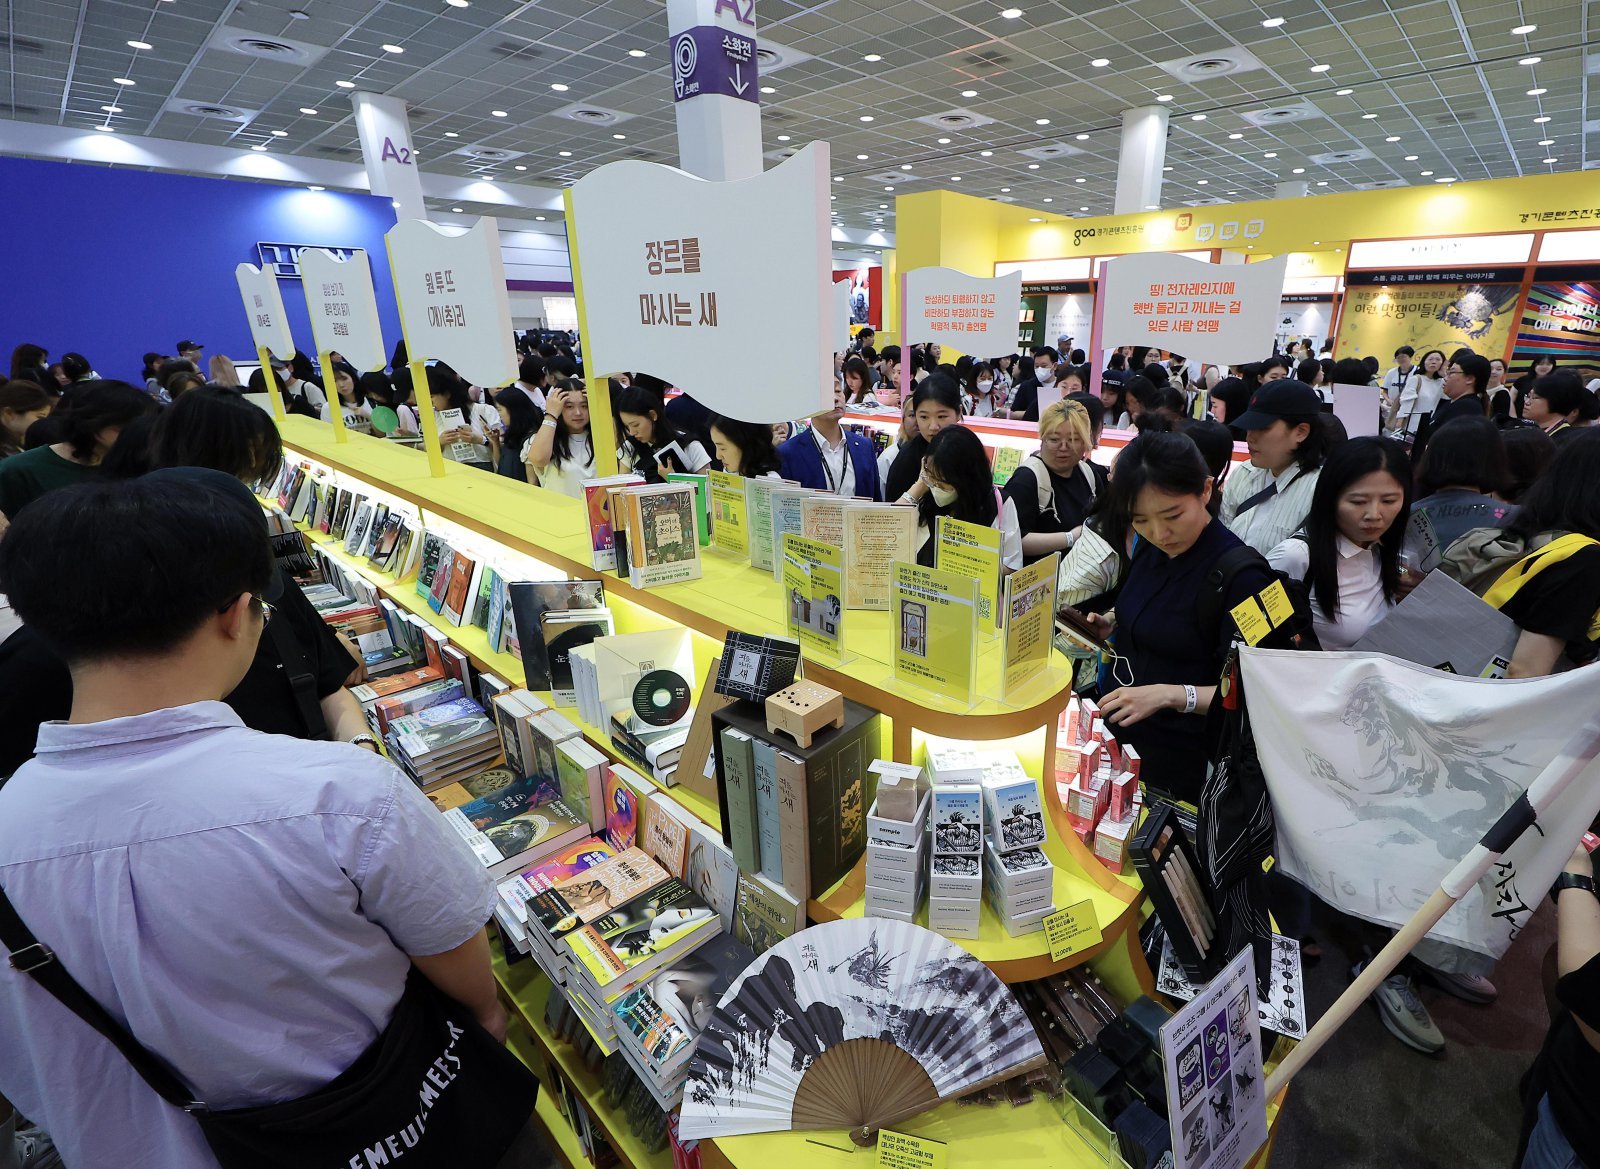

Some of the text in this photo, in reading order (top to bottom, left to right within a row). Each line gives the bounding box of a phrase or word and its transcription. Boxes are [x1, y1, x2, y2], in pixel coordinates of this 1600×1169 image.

[722, 35, 751, 57] 소화전
[685, 82, 699, 95] 소화전
[382, 136, 411, 164] A2
[1074, 228, 1095, 246] gca
[1096, 225, 1144, 236] 경기콘텐츠진흥원
[645, 237, 701, 275] 장르를
[1150, 281, 1235, 296] 띵! 전자레인지에
[981, 294, 995, 304] 않고
[640, 292, 717, 327] 마시는 새
[924, 308, 950, 318] 비판하되
[981, 308, 995, 318] 않는
[1133, 300, 1241, 314] 햇반 돌리고 꺼내는 걸
[1148, 320, 1219, 332] 잊은 사람 연맹
[879, 827, 901, 835] sample
[802, 959, 819, 973] 새
